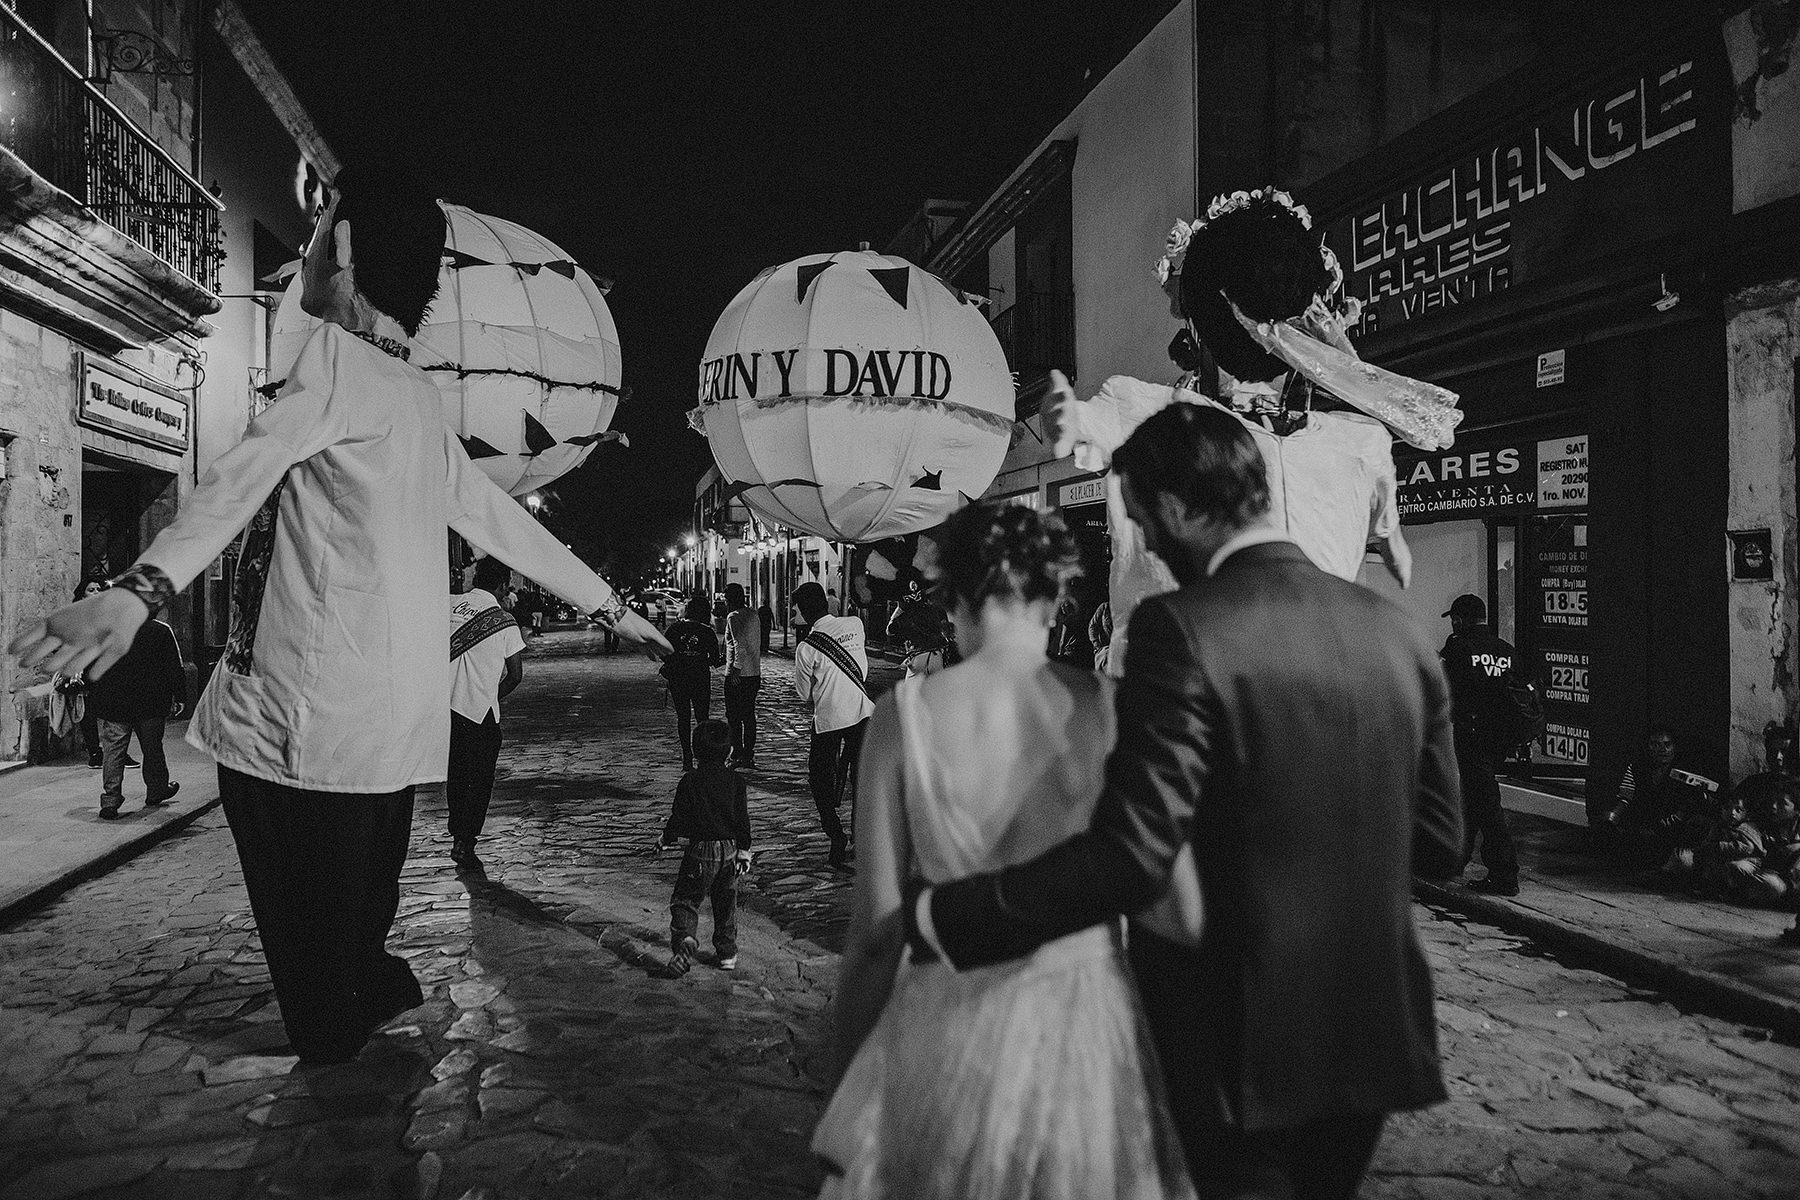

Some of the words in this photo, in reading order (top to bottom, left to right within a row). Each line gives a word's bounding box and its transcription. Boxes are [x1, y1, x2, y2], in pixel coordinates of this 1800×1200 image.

[1352, 61, 1696, 272] EXCHANGE
[1402, 267, 1509, 320] VENTA
[702, 353, 762, 402] ERIN
[771, 349, 799, 397] Y
[823, 349, 952, 400] DAVID
[1565, 443, 1586, 455] SAT
[1540, 458, 1578, 472] REGISTRO
[1562, 487, 1586, 500] NOV.
[1427, 498, 1477, 512] CAMBIARIO
[1479, 495, 1498, 507] S.A.
[1500, 493, 1514, 506] DE
[1516, 492, 1536, 504] C.V.
[1538, 552, 1567, 561] CAMBIO
[1568, 551, 1578, 561] DE
[1549, 565, 1569, 573] MONEY
[1541, 578, 1560, 588] COMPRA
[1546, 592, 1588, 612] 18.5
[1542, 615, 1567, 624] VENTA
[1545, 652, 1579, 664] COMPRA
[1546, 689, 1572, 701] COMPRA
[1546, 723, 1566, 734] COMPRA
